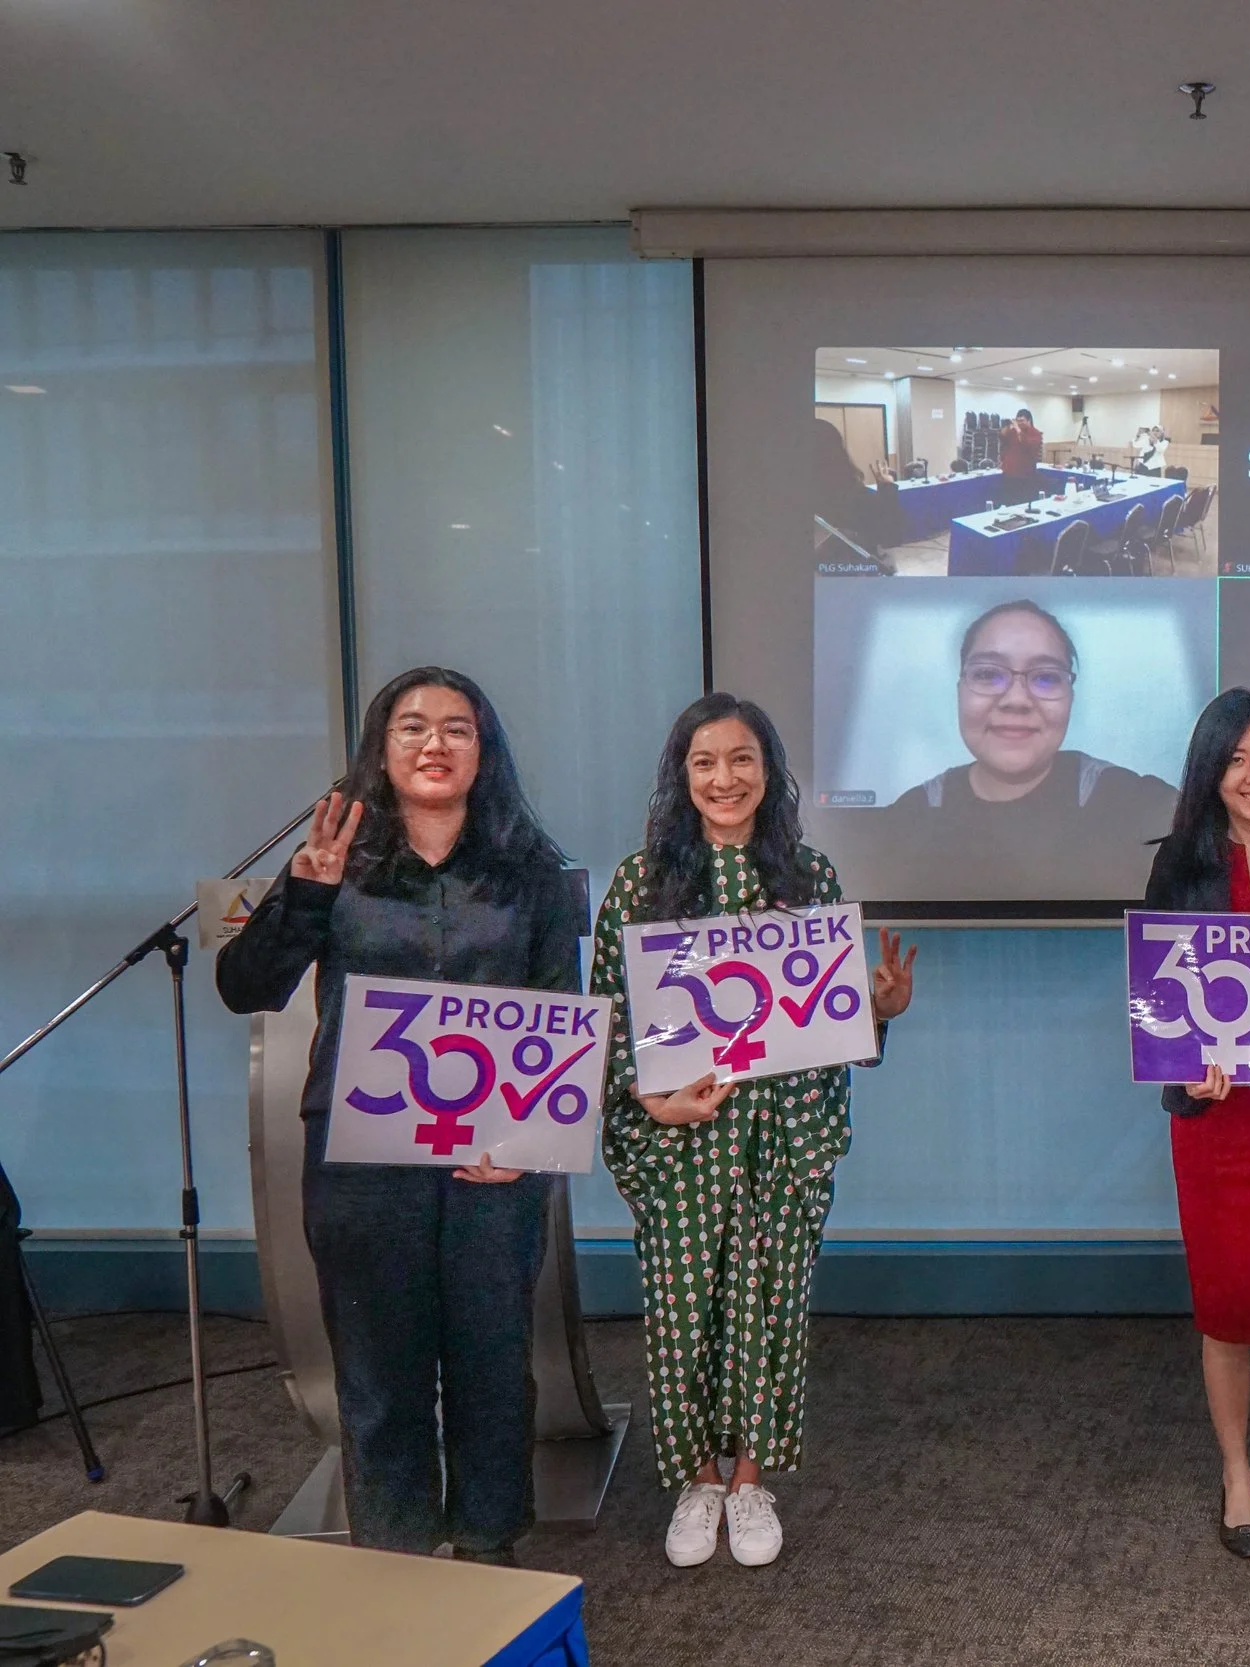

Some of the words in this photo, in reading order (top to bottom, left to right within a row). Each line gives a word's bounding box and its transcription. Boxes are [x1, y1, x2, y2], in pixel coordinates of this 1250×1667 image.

[837, 563, 878, 572] Suhakam
[707, 913, 854, 957] PROJEK
[438, 994, 600, 1038] PROJEK
[639, 928, 861, 1073] 30%
[344, 989, 597, 1156] 30%
